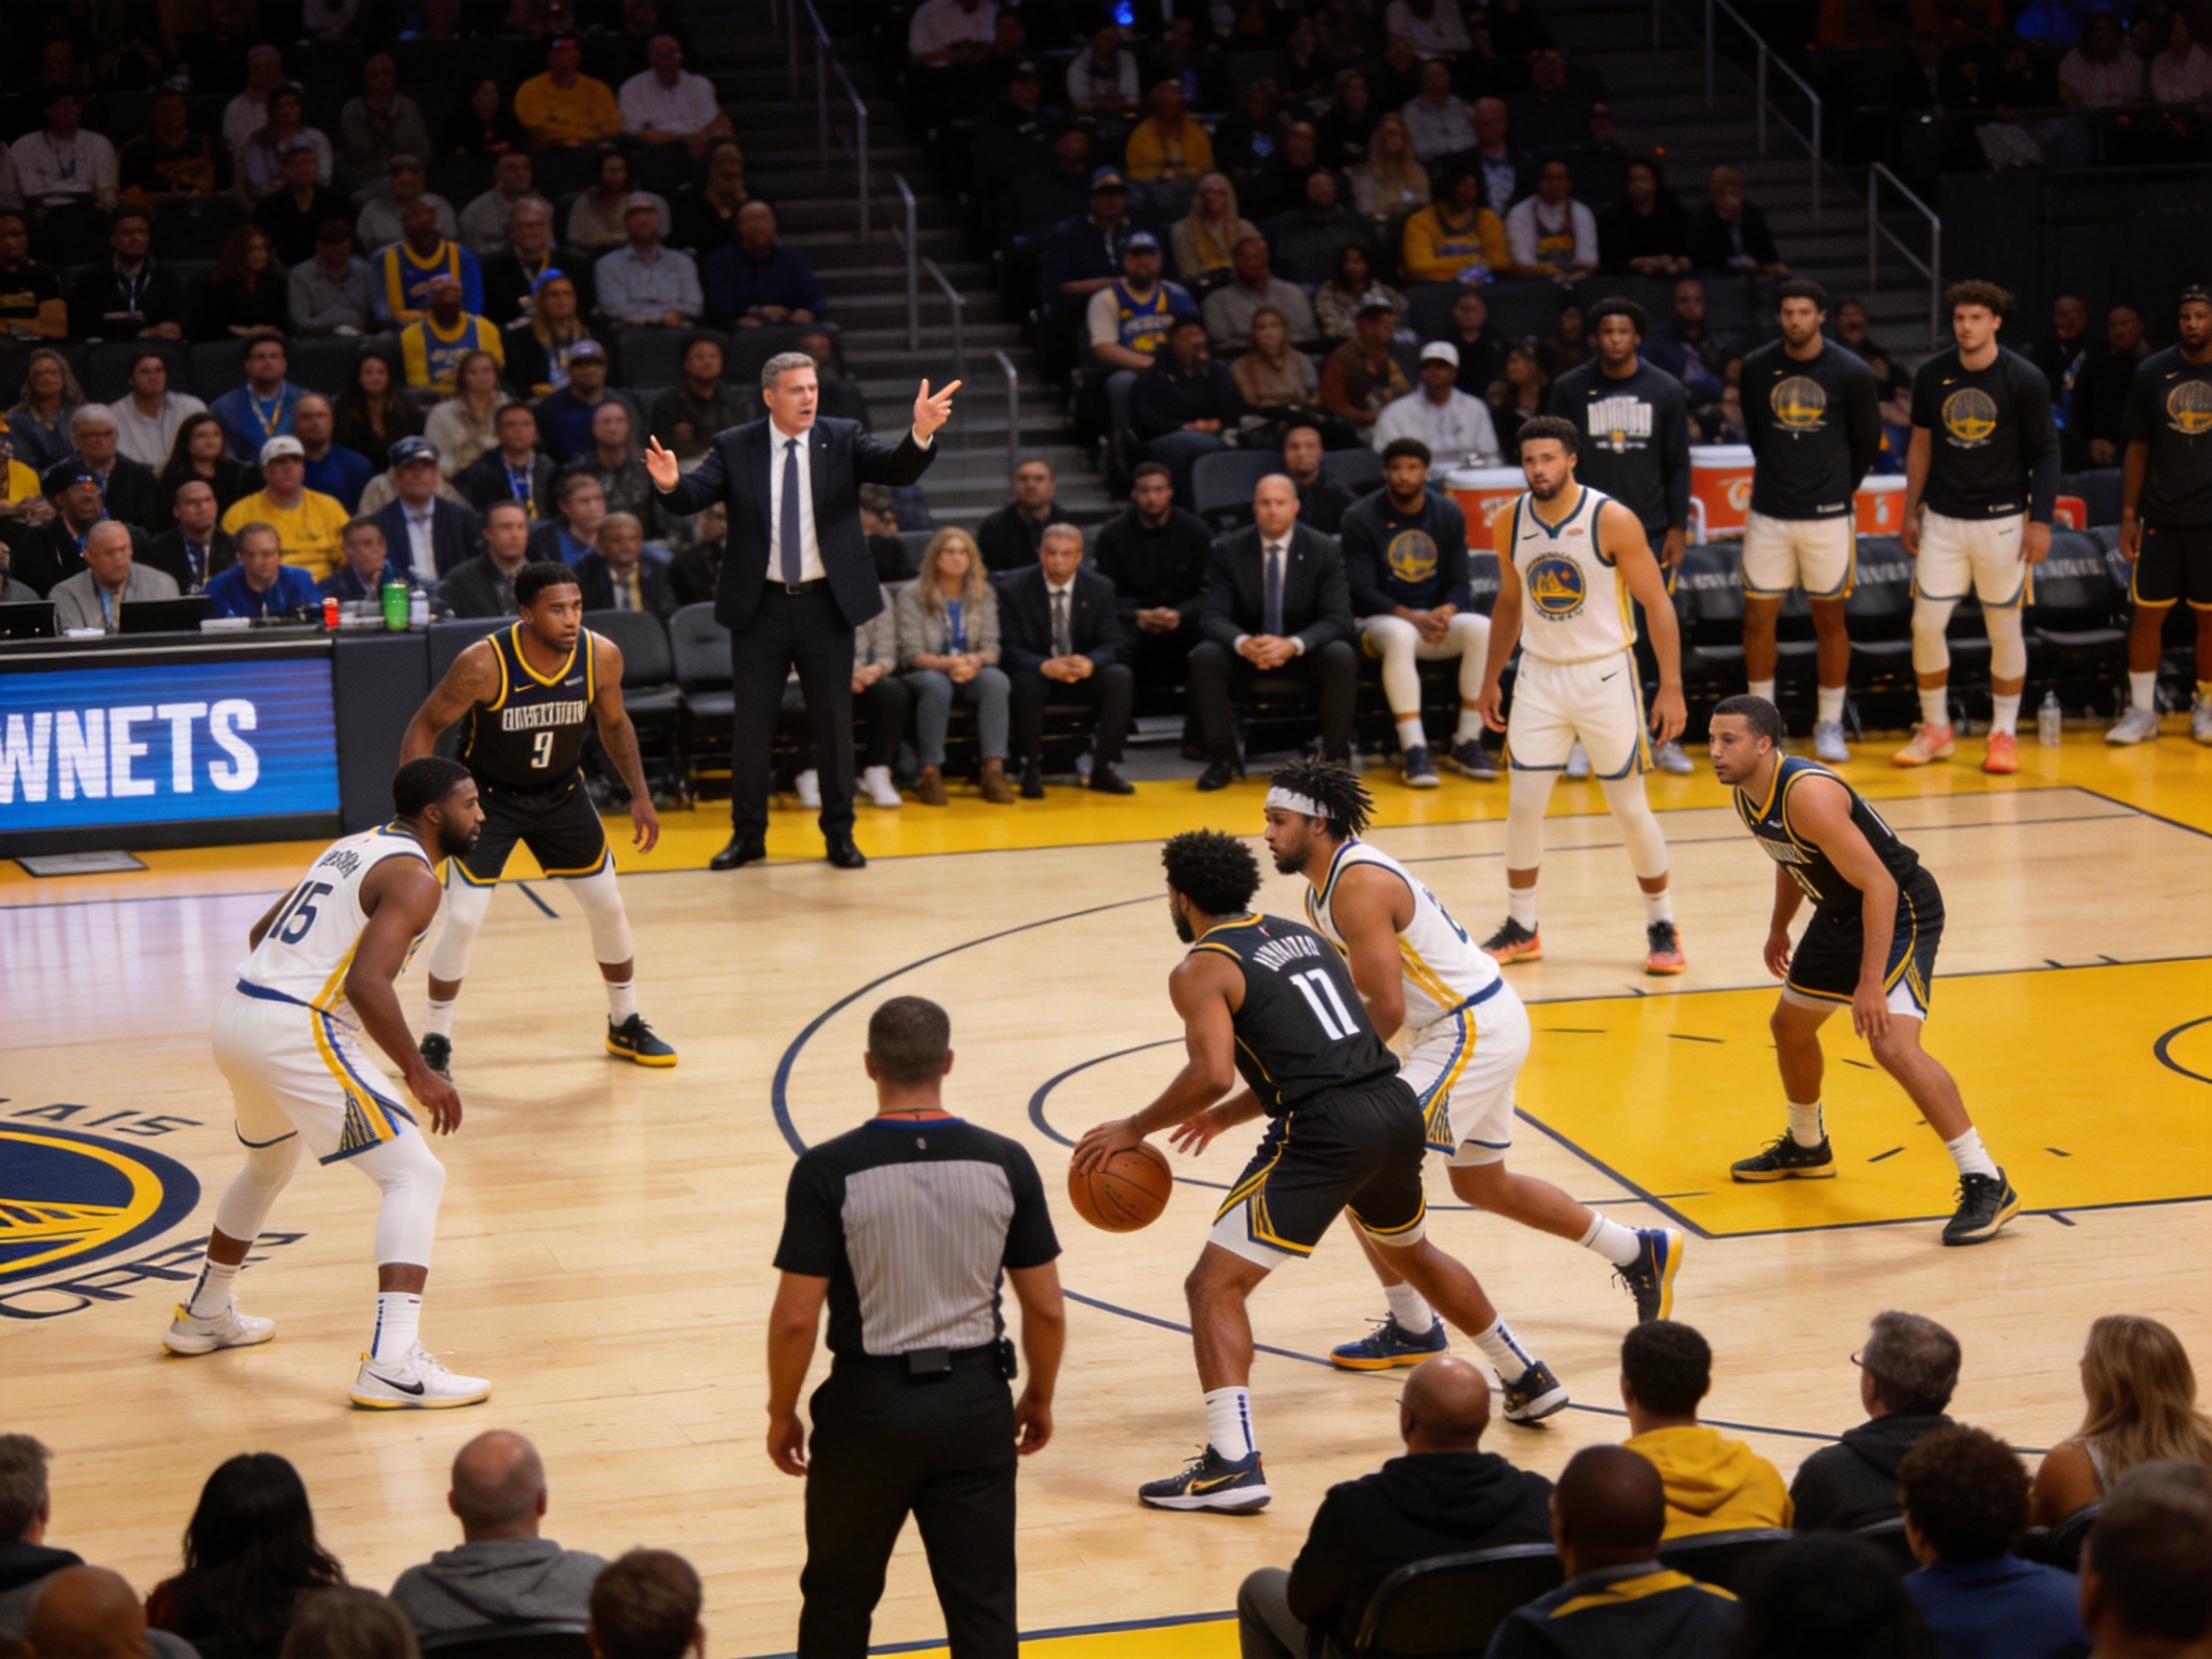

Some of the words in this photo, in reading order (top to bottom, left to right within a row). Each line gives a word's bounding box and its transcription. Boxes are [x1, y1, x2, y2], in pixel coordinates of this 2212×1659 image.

[0, 699, 259, 804] WNETS
[531, 731, 554, 768] 9
[268, 879, 334, 945] 15
